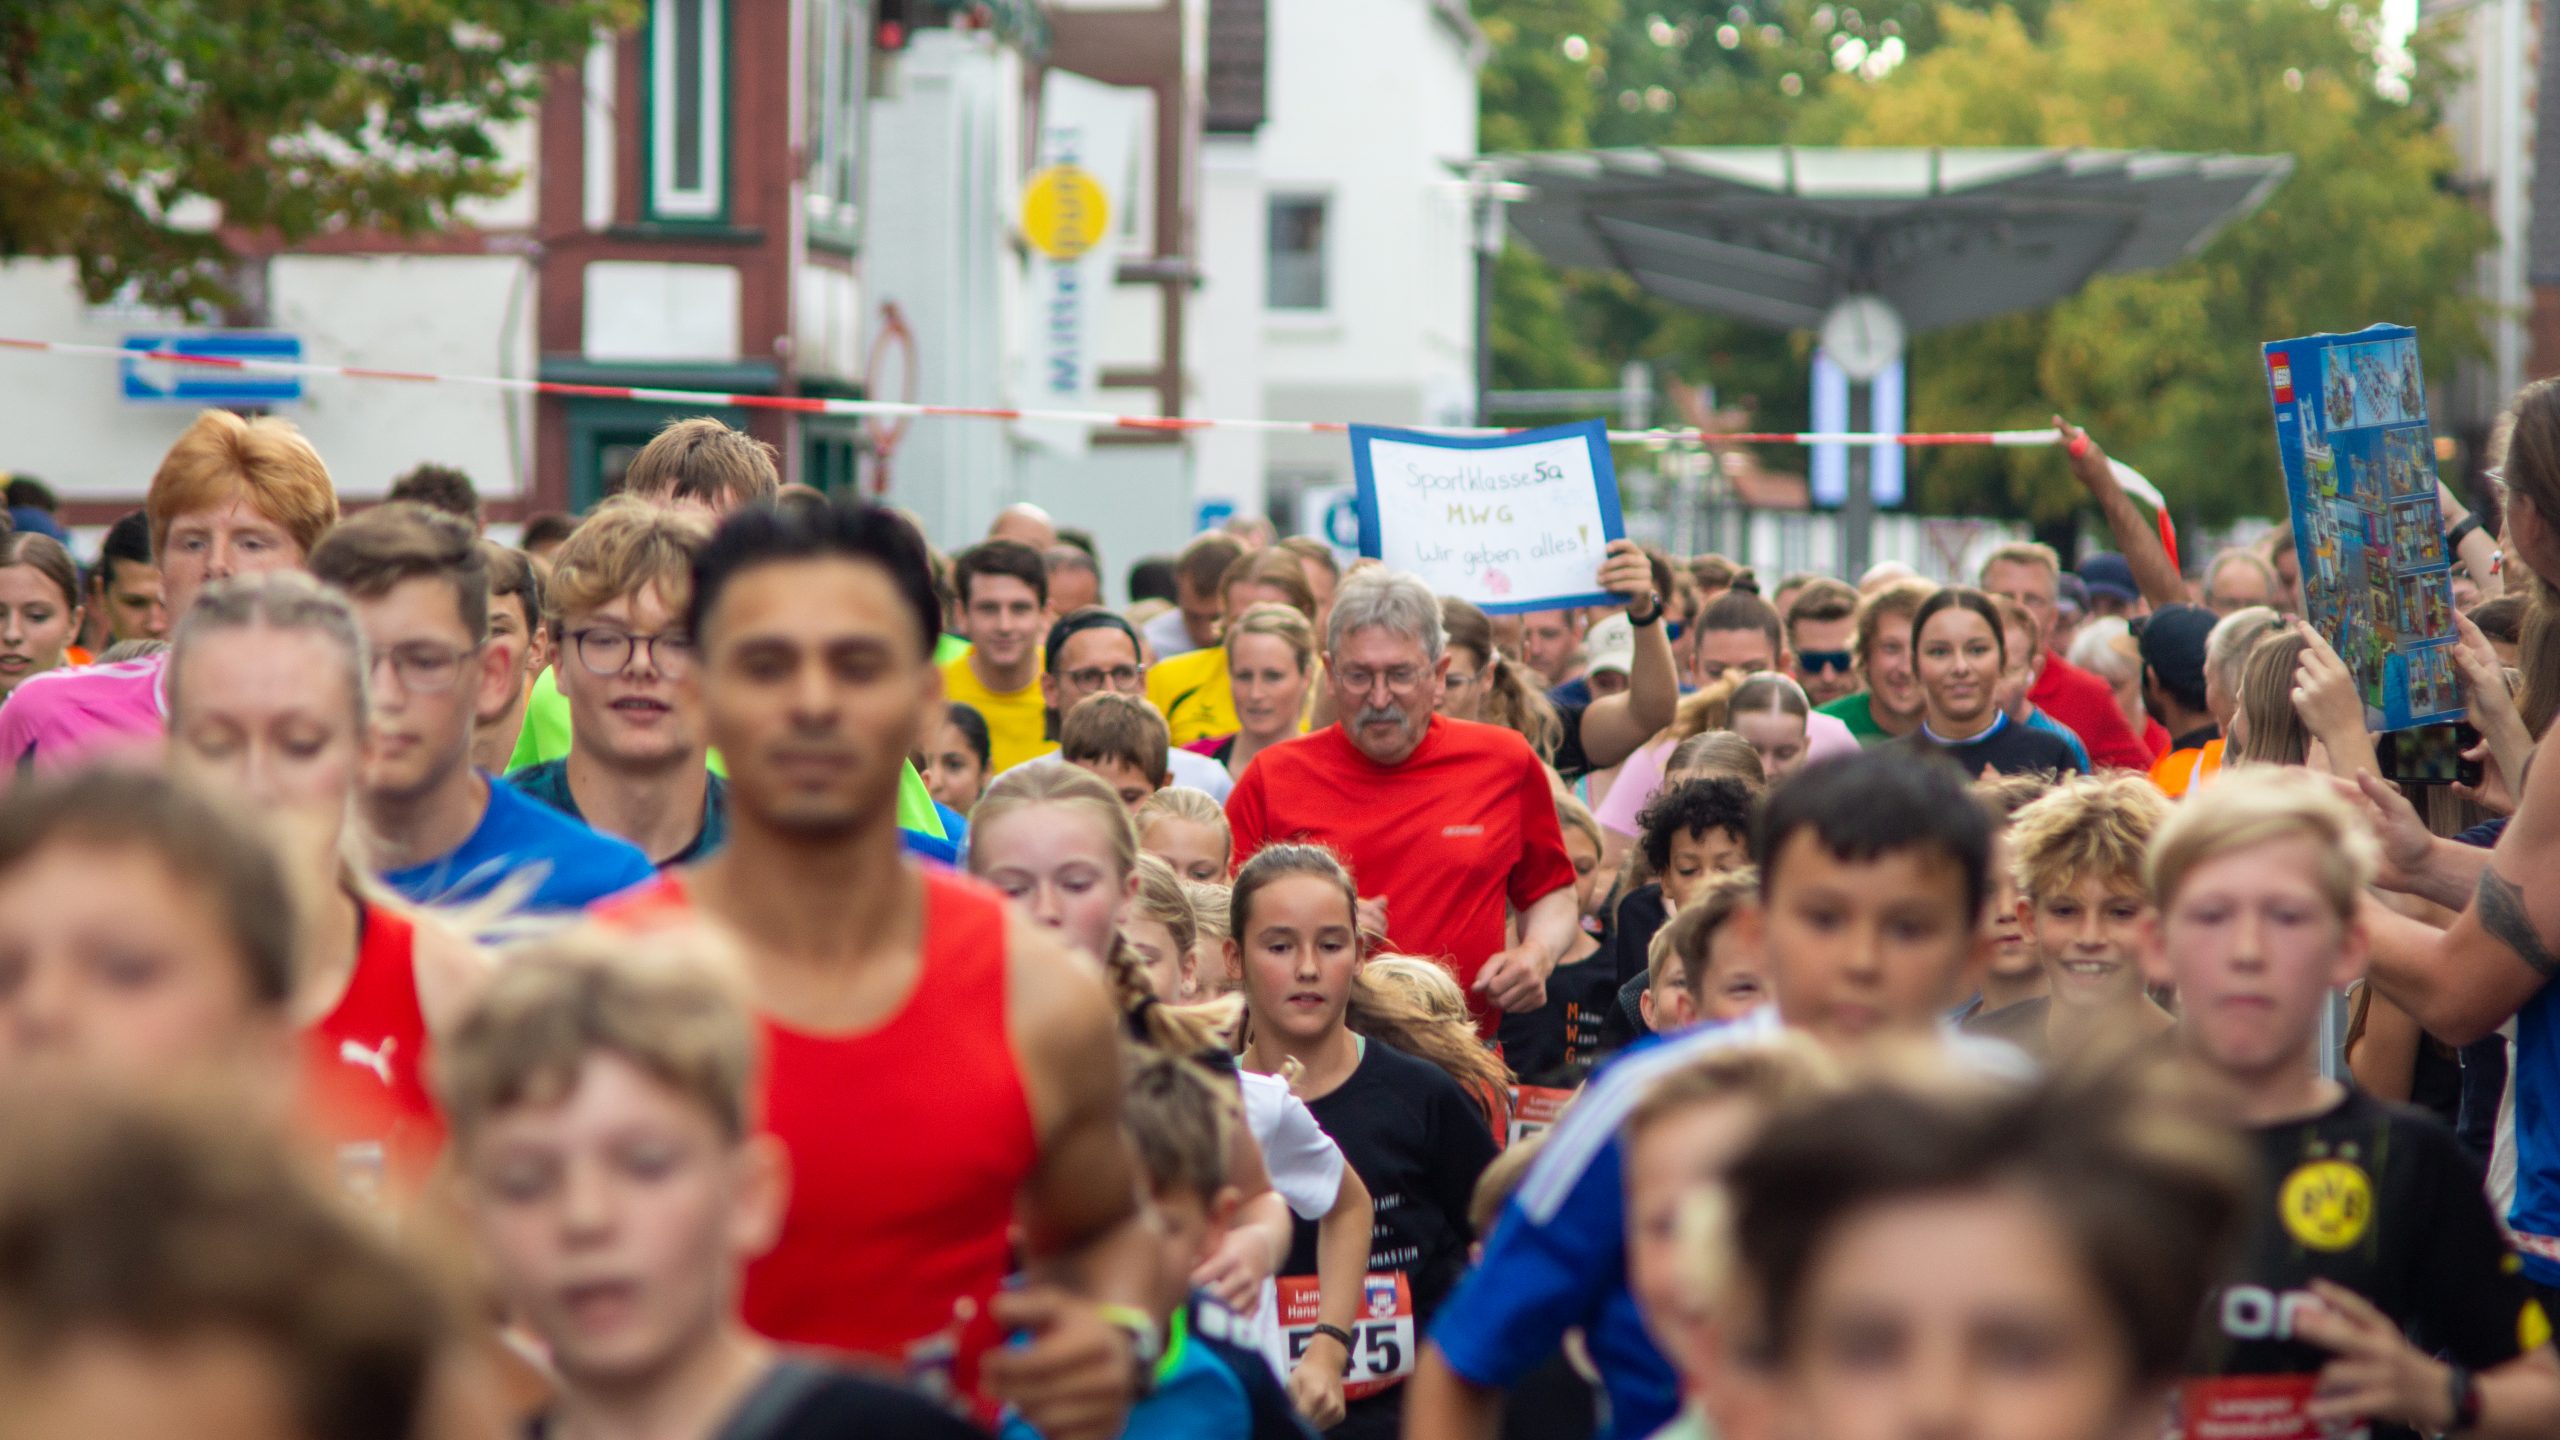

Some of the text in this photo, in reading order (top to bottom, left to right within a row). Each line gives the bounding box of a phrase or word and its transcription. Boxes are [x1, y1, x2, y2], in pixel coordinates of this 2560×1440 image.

[1416, 540, 1456, 563] Wir
[1463, 540, 1520, 576] geben
[1366, 1245, 1419, 1270] MNASIUM
